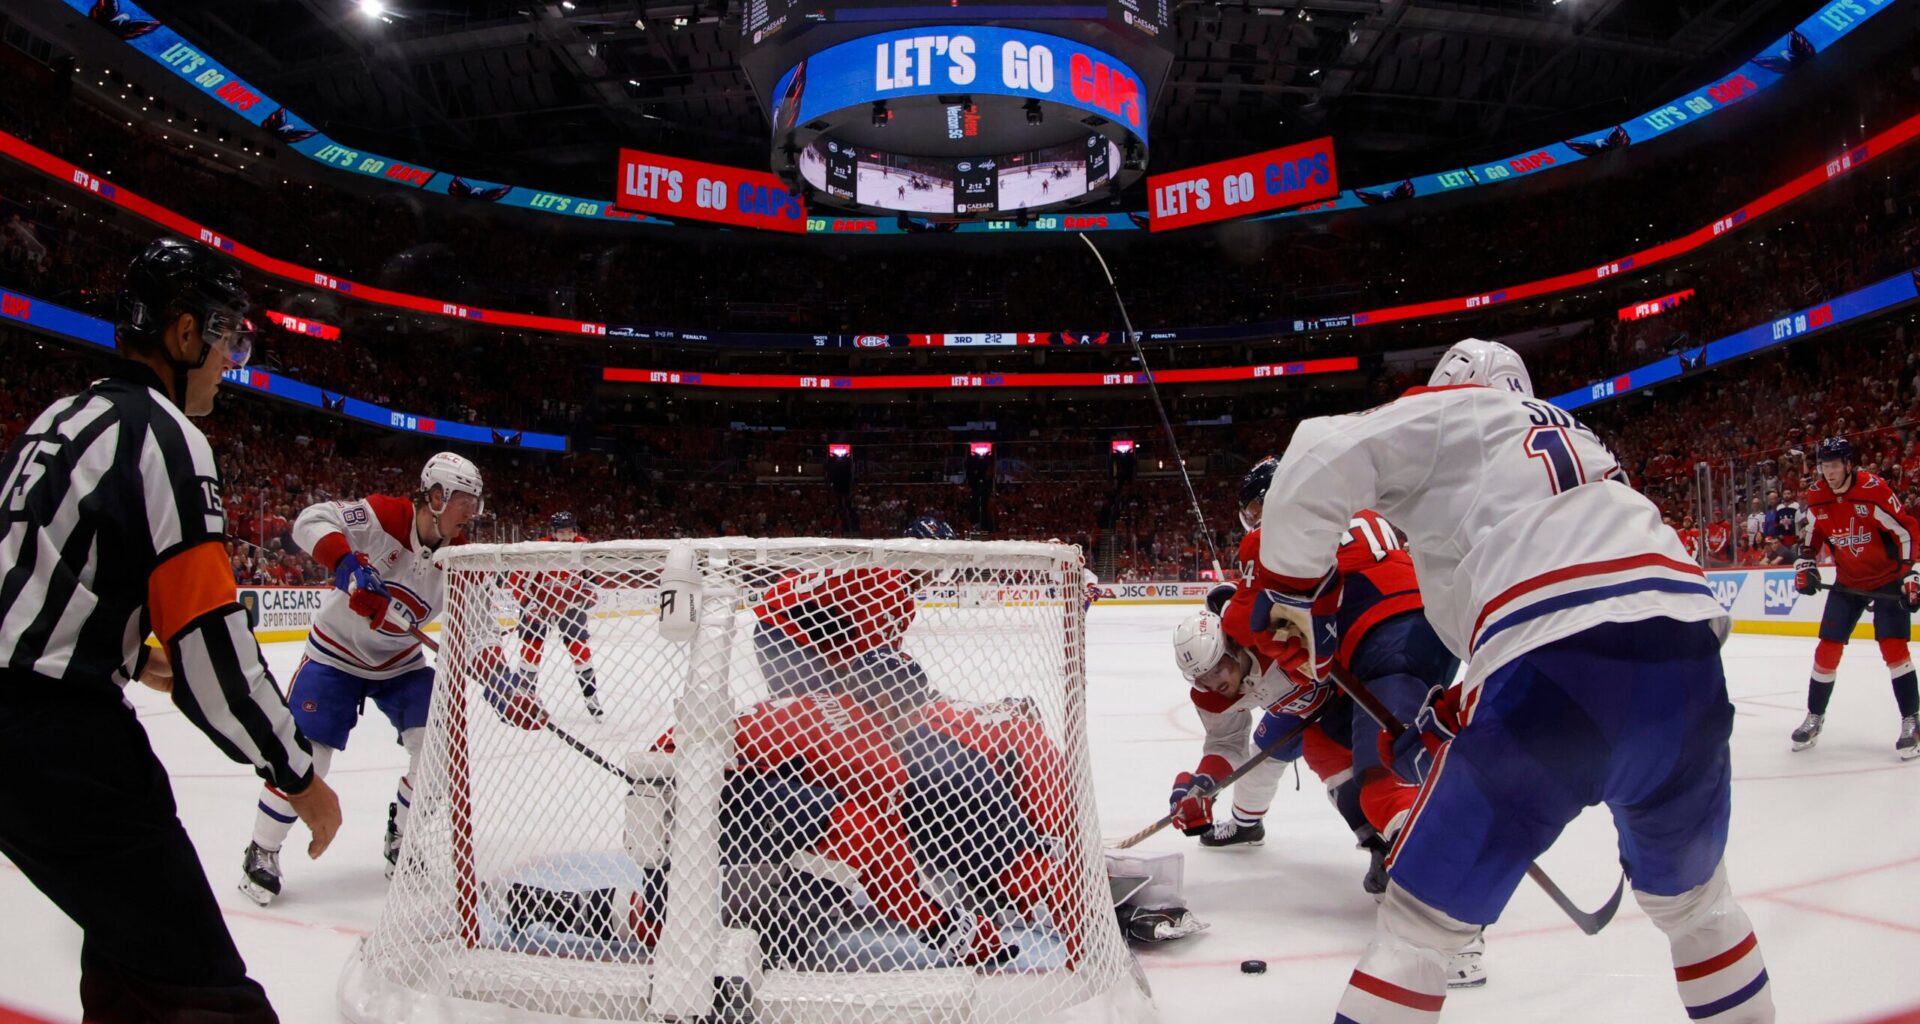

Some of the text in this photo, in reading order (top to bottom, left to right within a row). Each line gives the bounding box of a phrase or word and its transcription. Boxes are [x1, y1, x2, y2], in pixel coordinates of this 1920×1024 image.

[762, 15, 787, 34] CAESARS
[1819, 0, 1866, 31] LET'S
[1133, 16, 1158, 34] CAESARS
[160, 42, 262, 111] LET'S GO CAPS
[876, 36, 1140, 127] LET'S GO CAPS
[1644, 74, 1757, 130] LET'S GO CAPS
[947, 106, 963, 138] Verizon 5G
[314, 145, 433, 186] LET'S GO CAPS
[1437, 151, 1556, 188] LET'S GO CAPS
[985, 177, 990, 186] 3
[1155, 152, 1329, 218] LET'S GO CAPS
[626, 163, 801, 220] LET'S GO CAPS
[530, 194, 571, 211] LET'S
[575, 202, 598, 215] GO
[807, 220, 877, 232] GO CAPS
[1036, 218, 1056, 230] GO
[1063, 216, 1108, 229] CAPS
[2, 293, 30, 320] CAPS
[1773, 304, 1833, 340] LET'S GO CAPS
[925, 335, 931, 344] 1
[985, 334, 1002, 343] 2:12
[1028, 334, 1035, 343] 3
[240, 368, 249, 384] GO
[251, 370, 270, 390] CAPS
[650, 372, 667, 382] LET'S
[670, 374, 680, 383] GO
[1103, 375, 1120, 385] LET'S
[1124, 376, 1133, 384] GO
[1254, 367, 1270, 377] LET'S
[1274, 367, 1283, 376] GO
[800, 378, 817, 387] LET'S
[820, 379, 830, 388] GO
[952, 377, 969, 386] LET'S
[972, 377, 982, 386] GO
[1507, 377, 1523, 392] 14
[1592, 383, 1605, 399] LET'S
[1606, 382, 1614, 396] GO
[391, 411, 405, 428] LET'S
[407, 417, 416, 429] GO
[200, 481, 223, 512] 15
[262, 590, 322, 610] CAESARS
[1183, 586, 1208, 596] ESPN
[1711, 580, 1738, 607] SAP
[1765, 579, 1798, 608] SAP
[263, 612, 312, 628] SPORTSBOOK
[1184, 651, 1192, 662] 11
